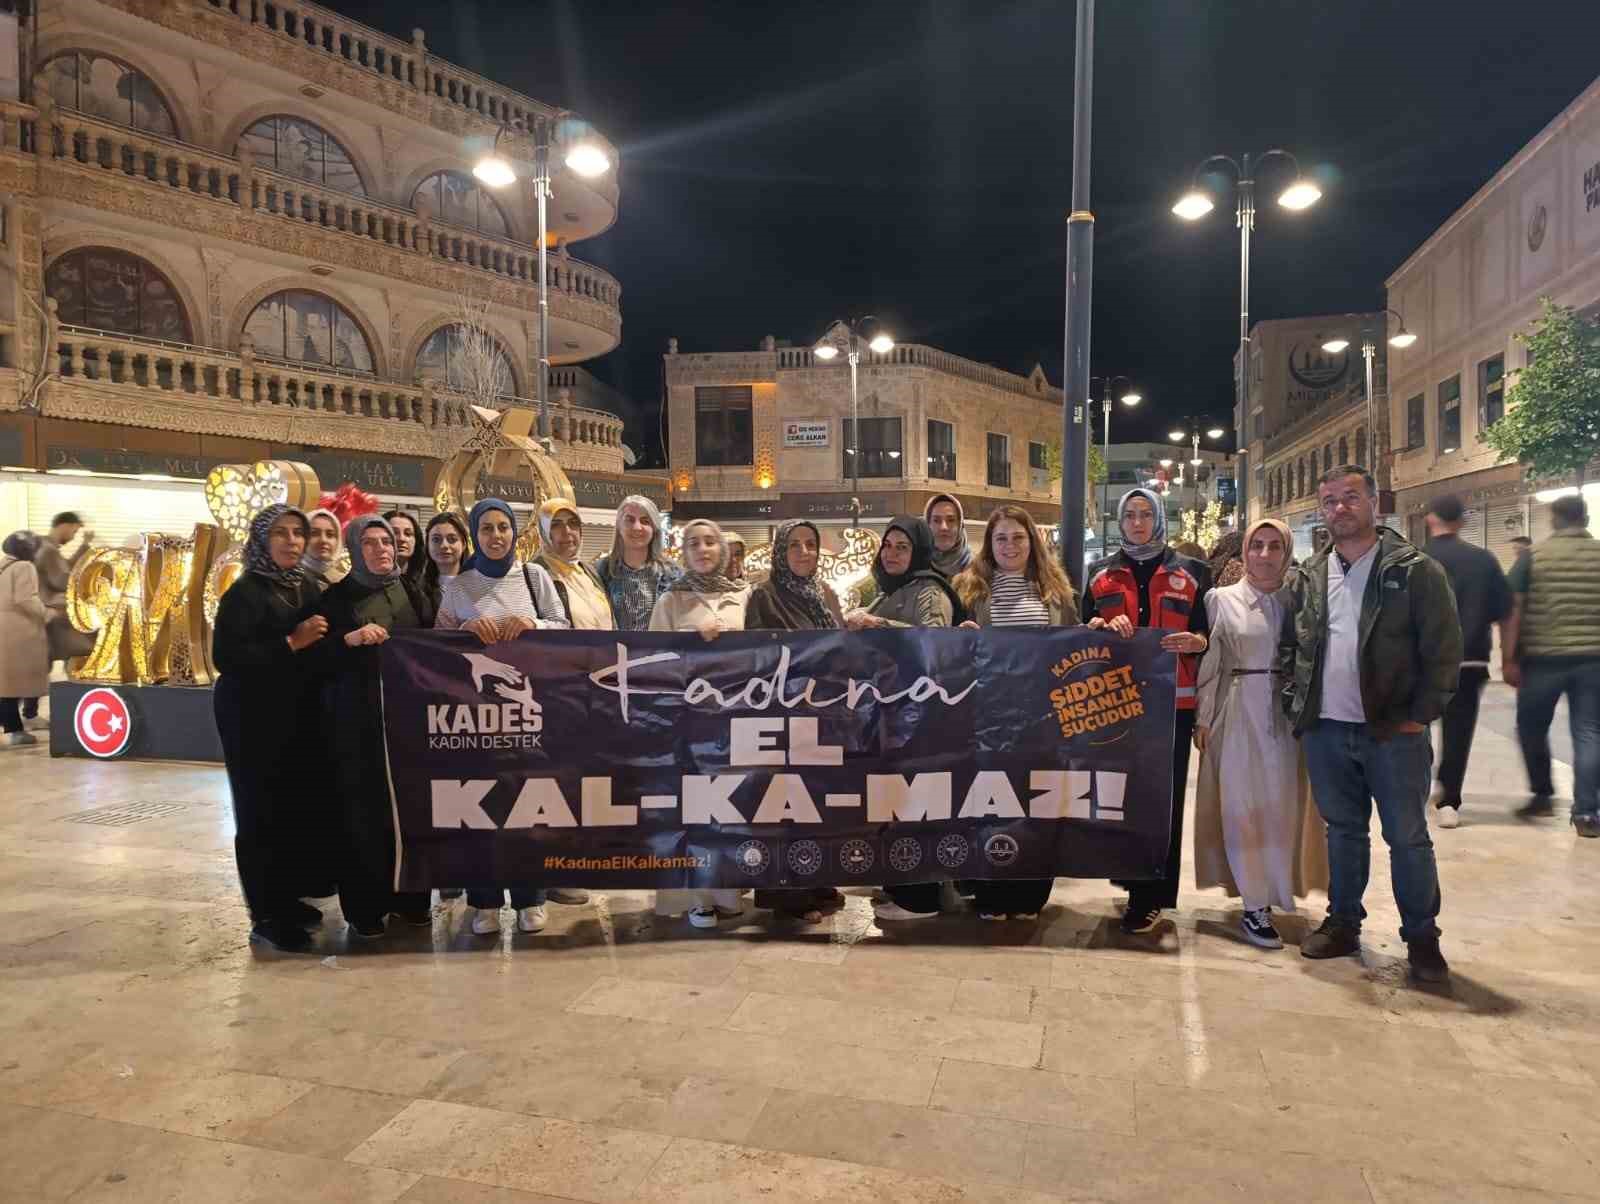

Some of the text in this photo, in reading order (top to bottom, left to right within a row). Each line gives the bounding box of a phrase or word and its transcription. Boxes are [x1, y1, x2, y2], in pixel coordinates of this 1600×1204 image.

[1048, 646, 1112, 678] KADINA
[589, 642, 978, 724] Kadına
[427, 703, 543, 734] KADES
[429, 735, 542, 749] KADIN DESTEK
[730, 717, 844, 766] EL
[430, 770, 1127, 829] KAL-KA-MAZ!
